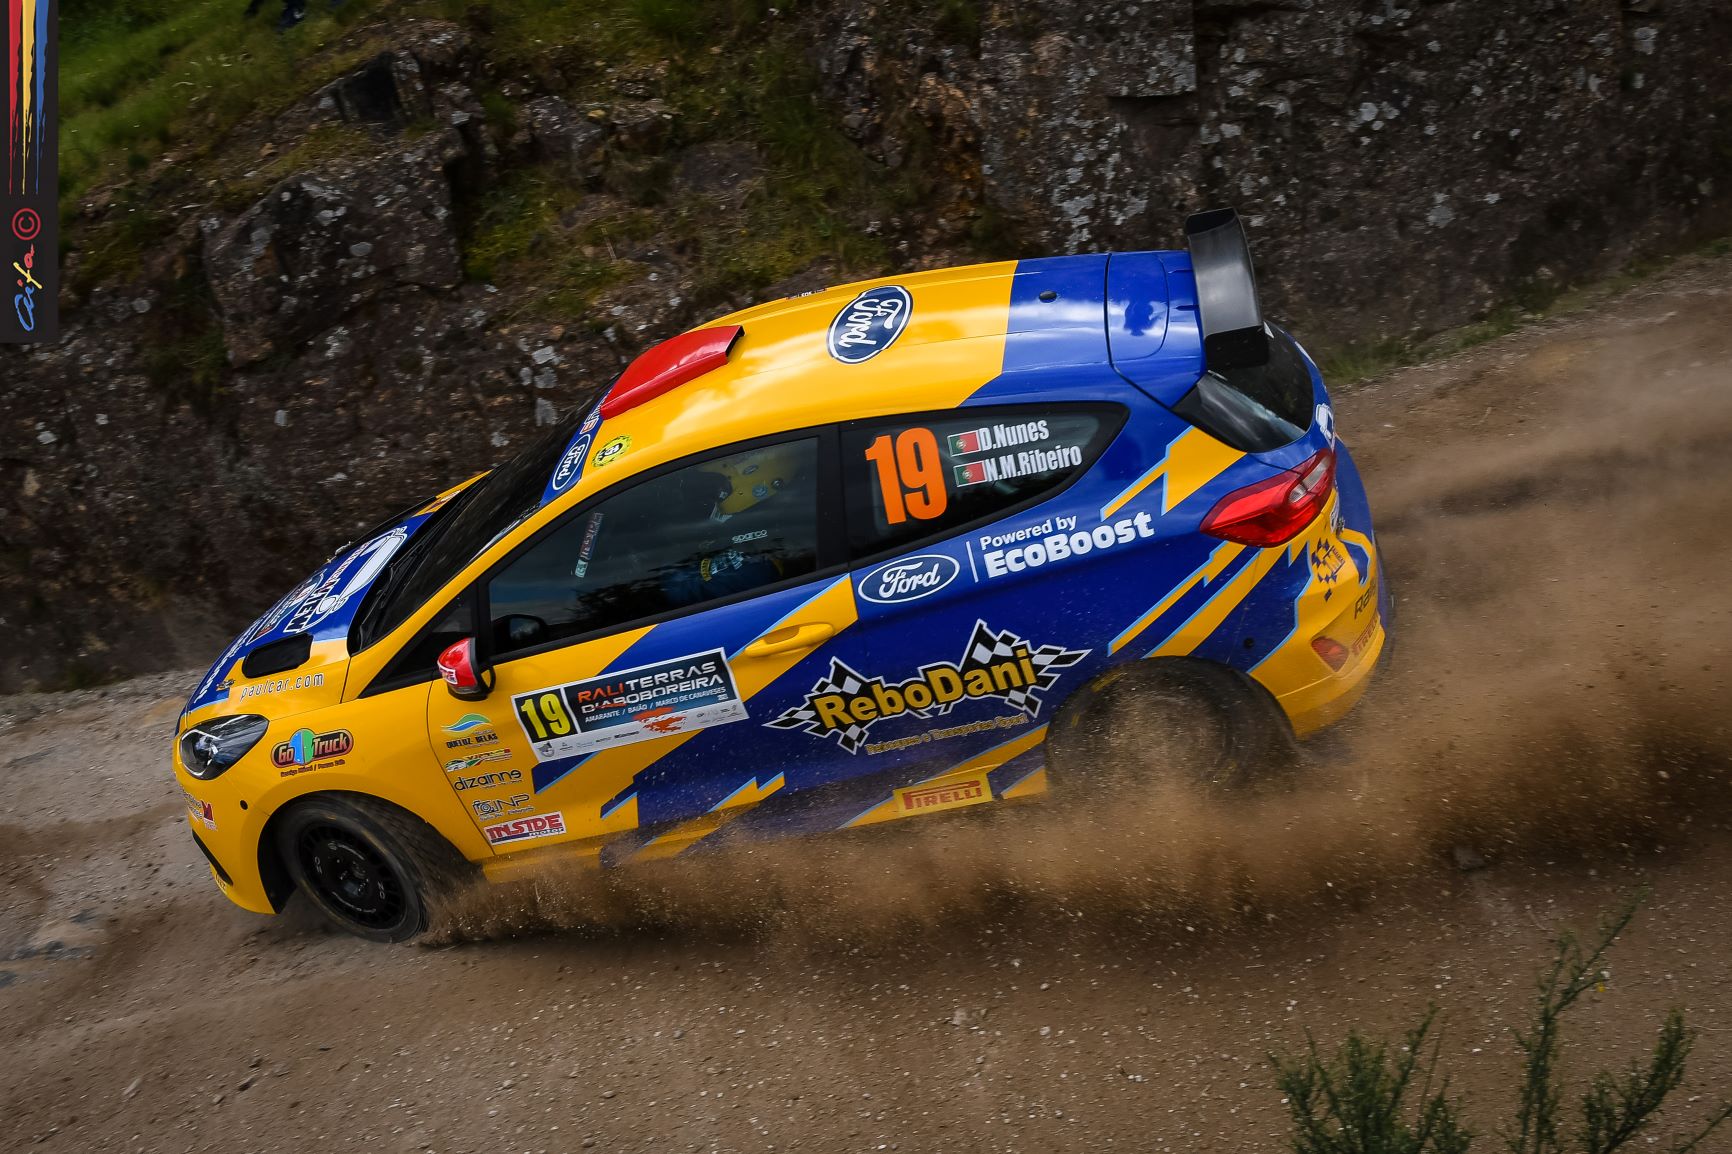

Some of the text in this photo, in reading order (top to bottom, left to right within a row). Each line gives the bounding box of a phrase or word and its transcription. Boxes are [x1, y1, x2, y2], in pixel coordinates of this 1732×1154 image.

[837, 297, 904, 348] Ford
[980, 419, 1050, 452] D.Nunes
[865, 427, 948, 525] 19
[984, 444, 1083, 483] N.M.Ribeiro
[979, 514, 1077, 551] Powered by
[983, 509, 1156, 579] EcoBoost
[878, 560, 941, 599] Ford
[240, 672, 325, 703] paulcar.com
[577, 661, 718, 704] RALI TERRAS
[812, 647, 1038, 730] ReboDani
[521, 693, 571, 739] 19
[585, 709, 621, 723] AMARANTE
[278, 744, 294, 763] Go
[313, 732, 348, 756] Truck
[902, 780, 983, 811] PIRELLI
[484, 814, 562, 839] INSIDE
